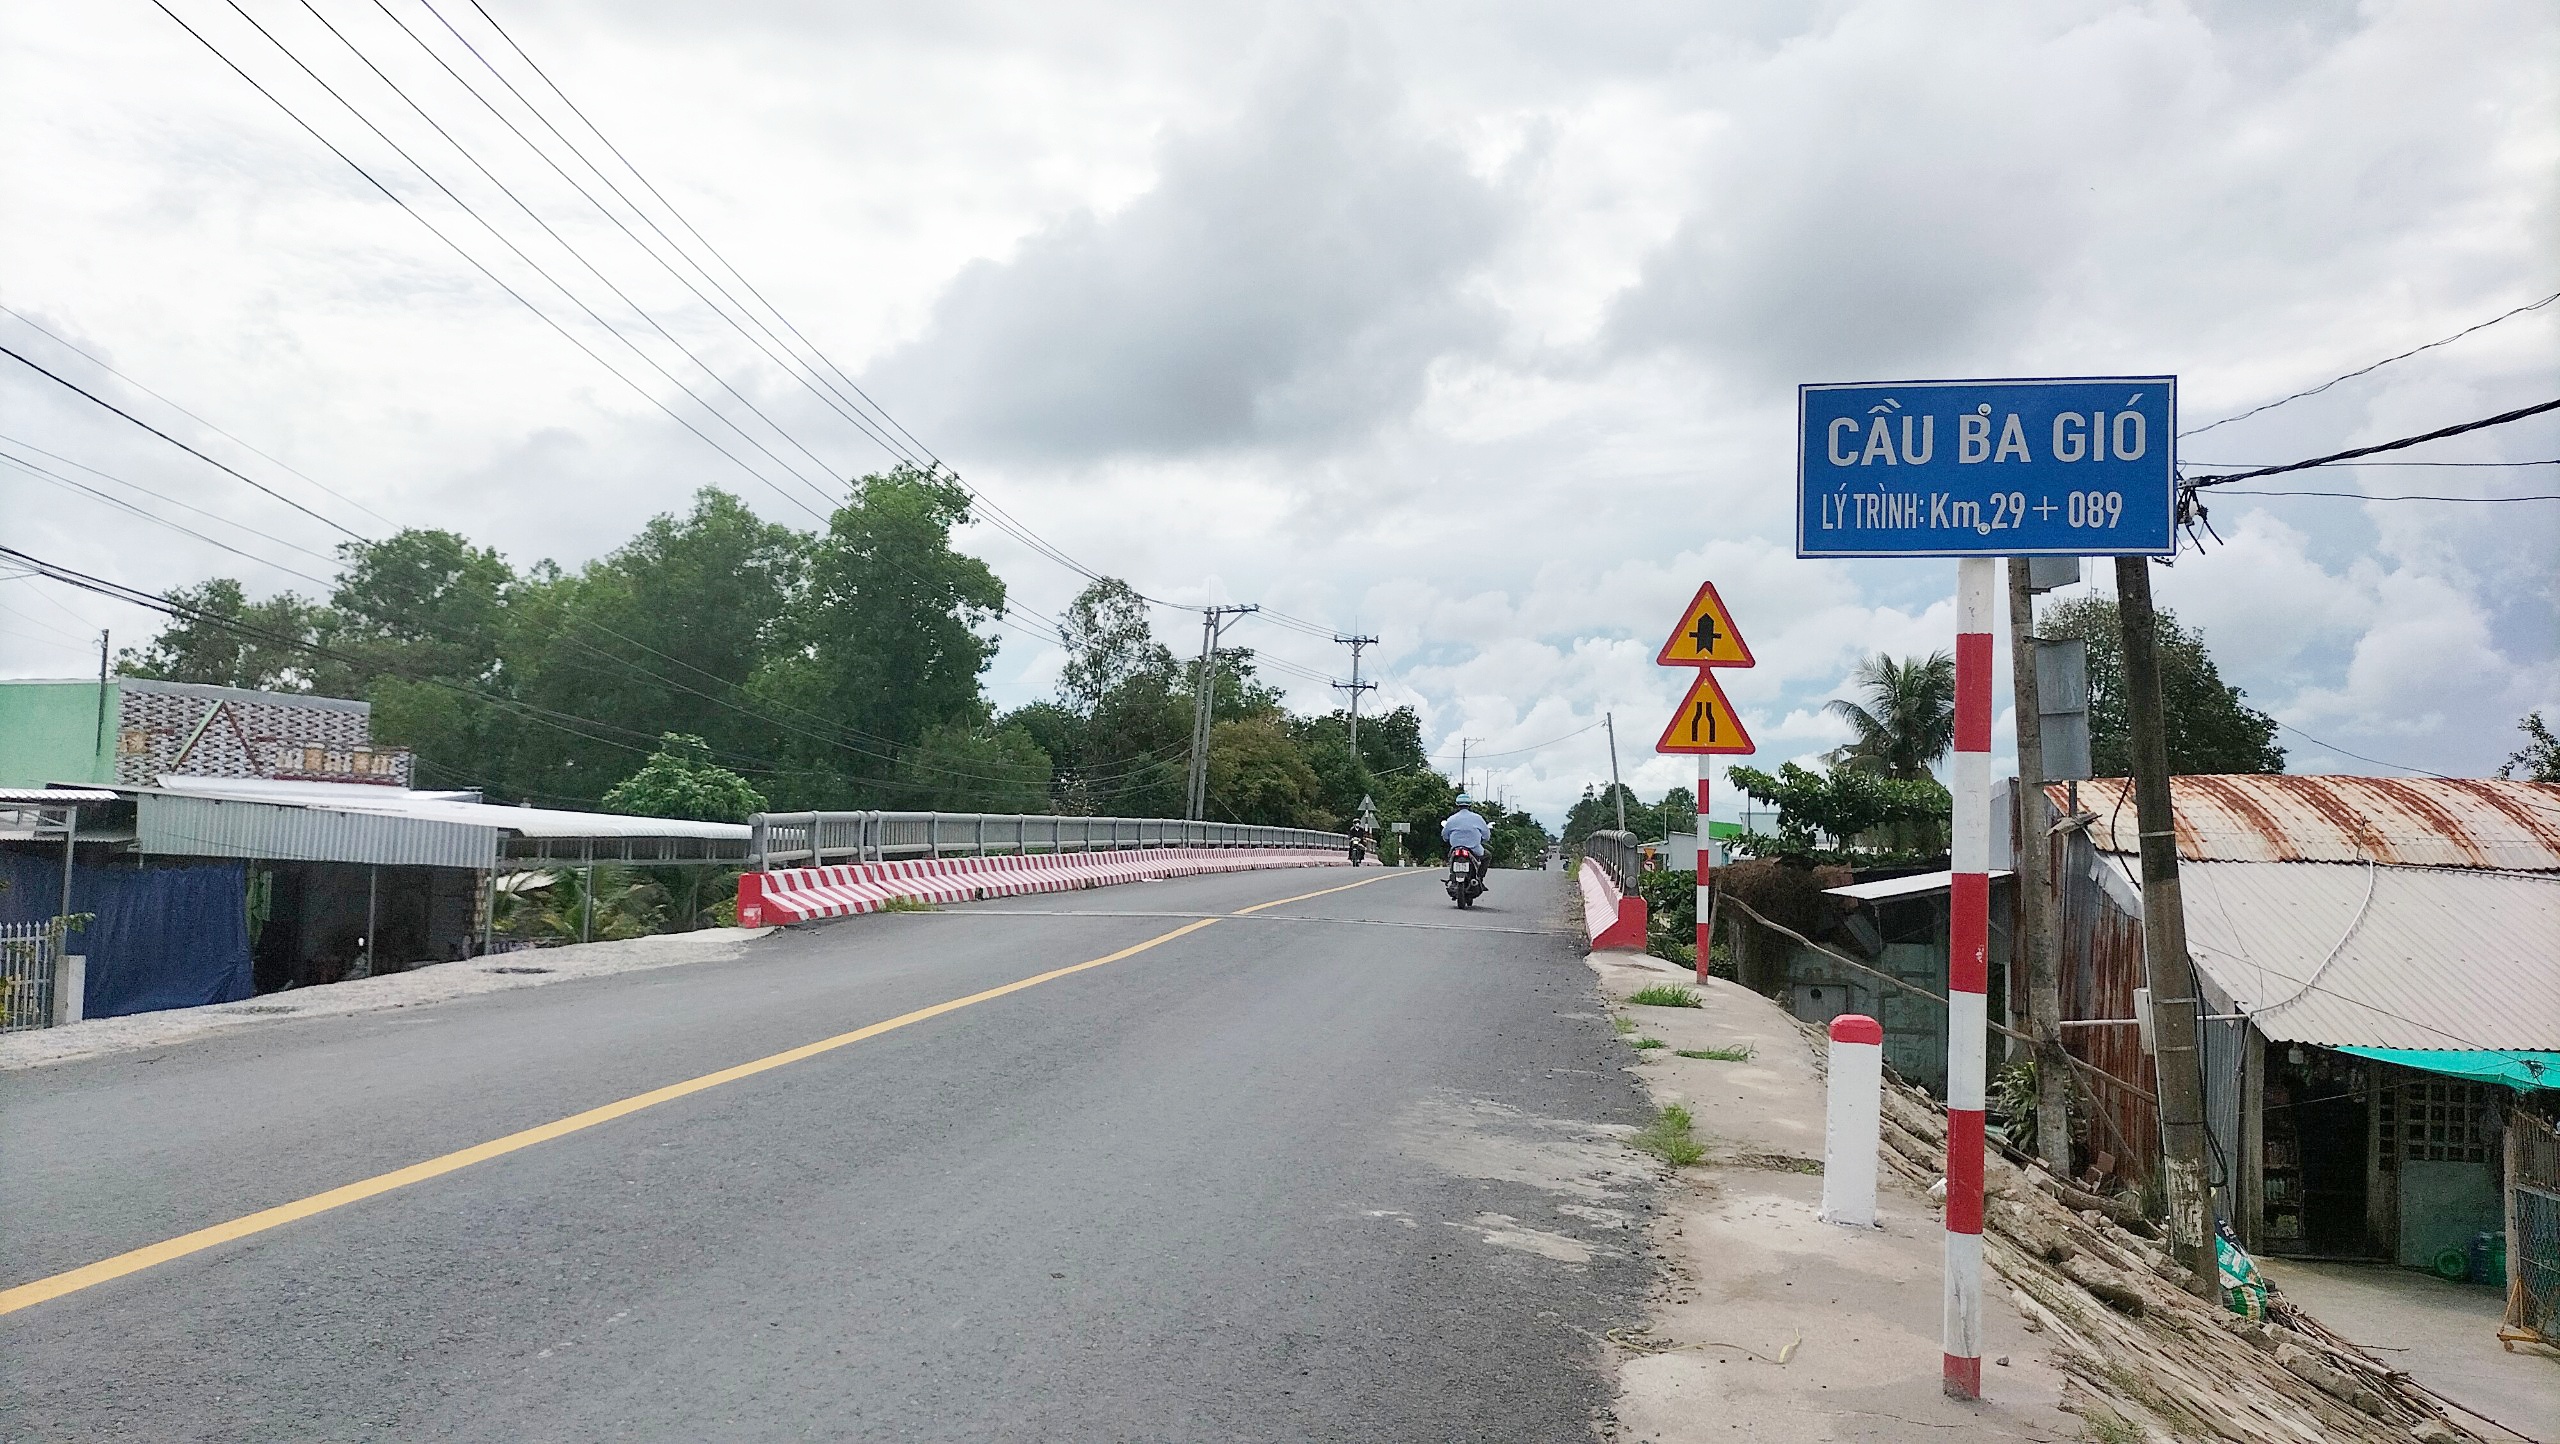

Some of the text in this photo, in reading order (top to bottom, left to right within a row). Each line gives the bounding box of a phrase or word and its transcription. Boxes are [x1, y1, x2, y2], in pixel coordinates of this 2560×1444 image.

[1828, 392, 2146, 466] CẦU BA GIÓ
[1822, 482, 2123, 530] LÝ TRÌNH: Km 29 + 089
